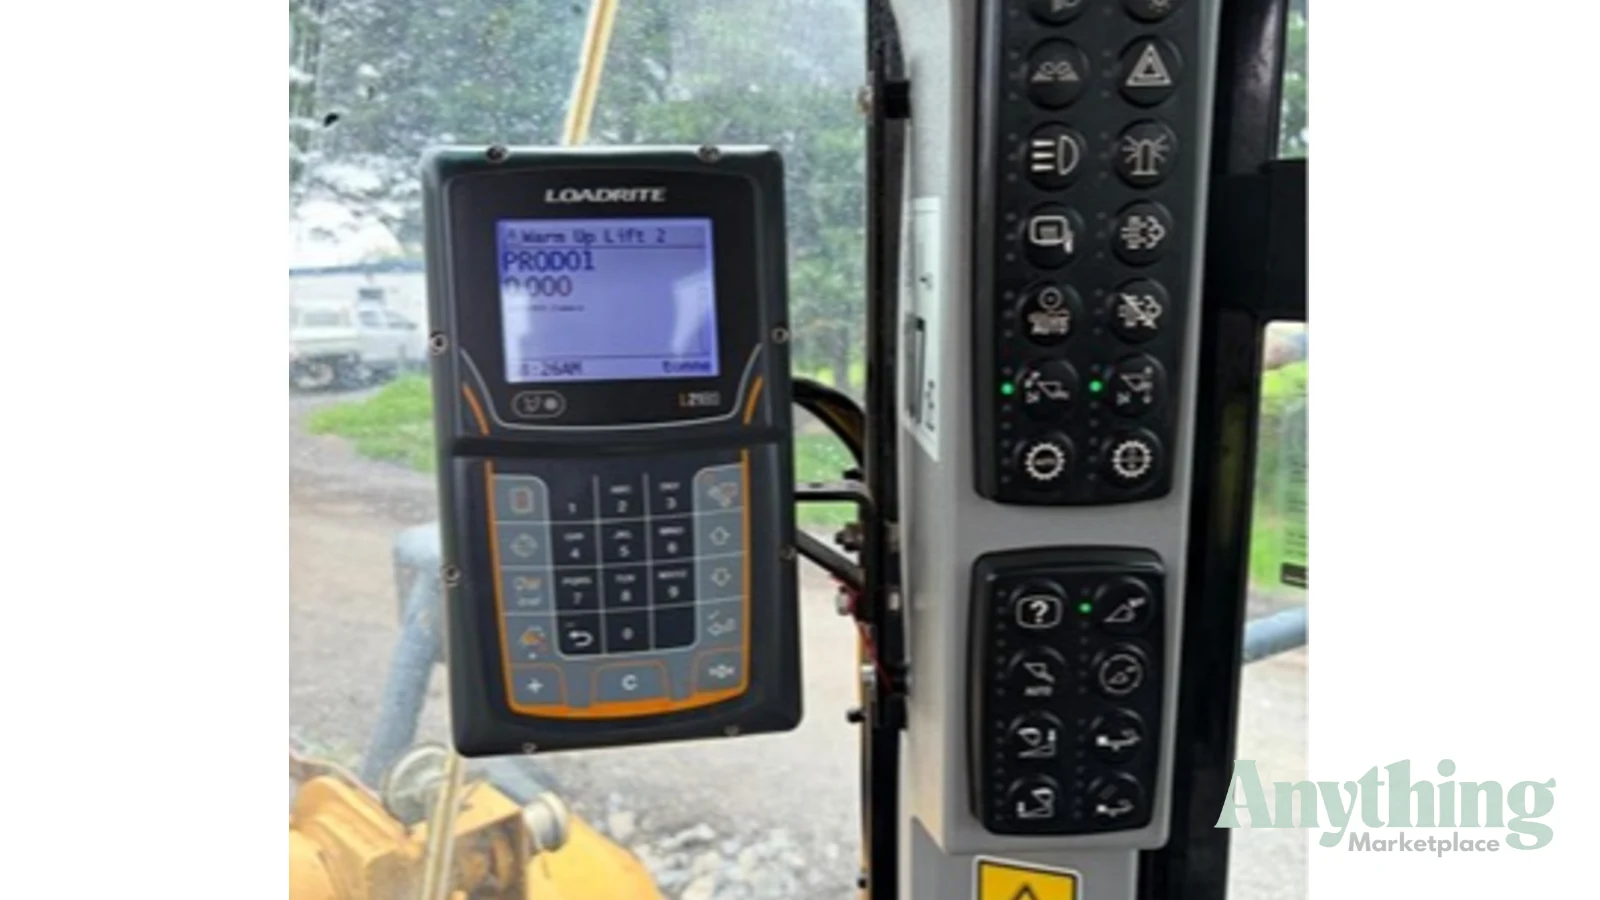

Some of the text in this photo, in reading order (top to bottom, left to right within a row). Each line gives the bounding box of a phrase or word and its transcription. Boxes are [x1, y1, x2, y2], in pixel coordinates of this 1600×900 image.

[545, 187, 667, 203] LOADRITE
[521, 228, 667, 248] Warm Up Lift 2
[502, 250, 595, 272] PROD01
[504, 275, 573, 297] 0000
[617, 500, 628, 513] 2
[666, 496, 678, 510] 3
[621, 673, 639, 691] C
